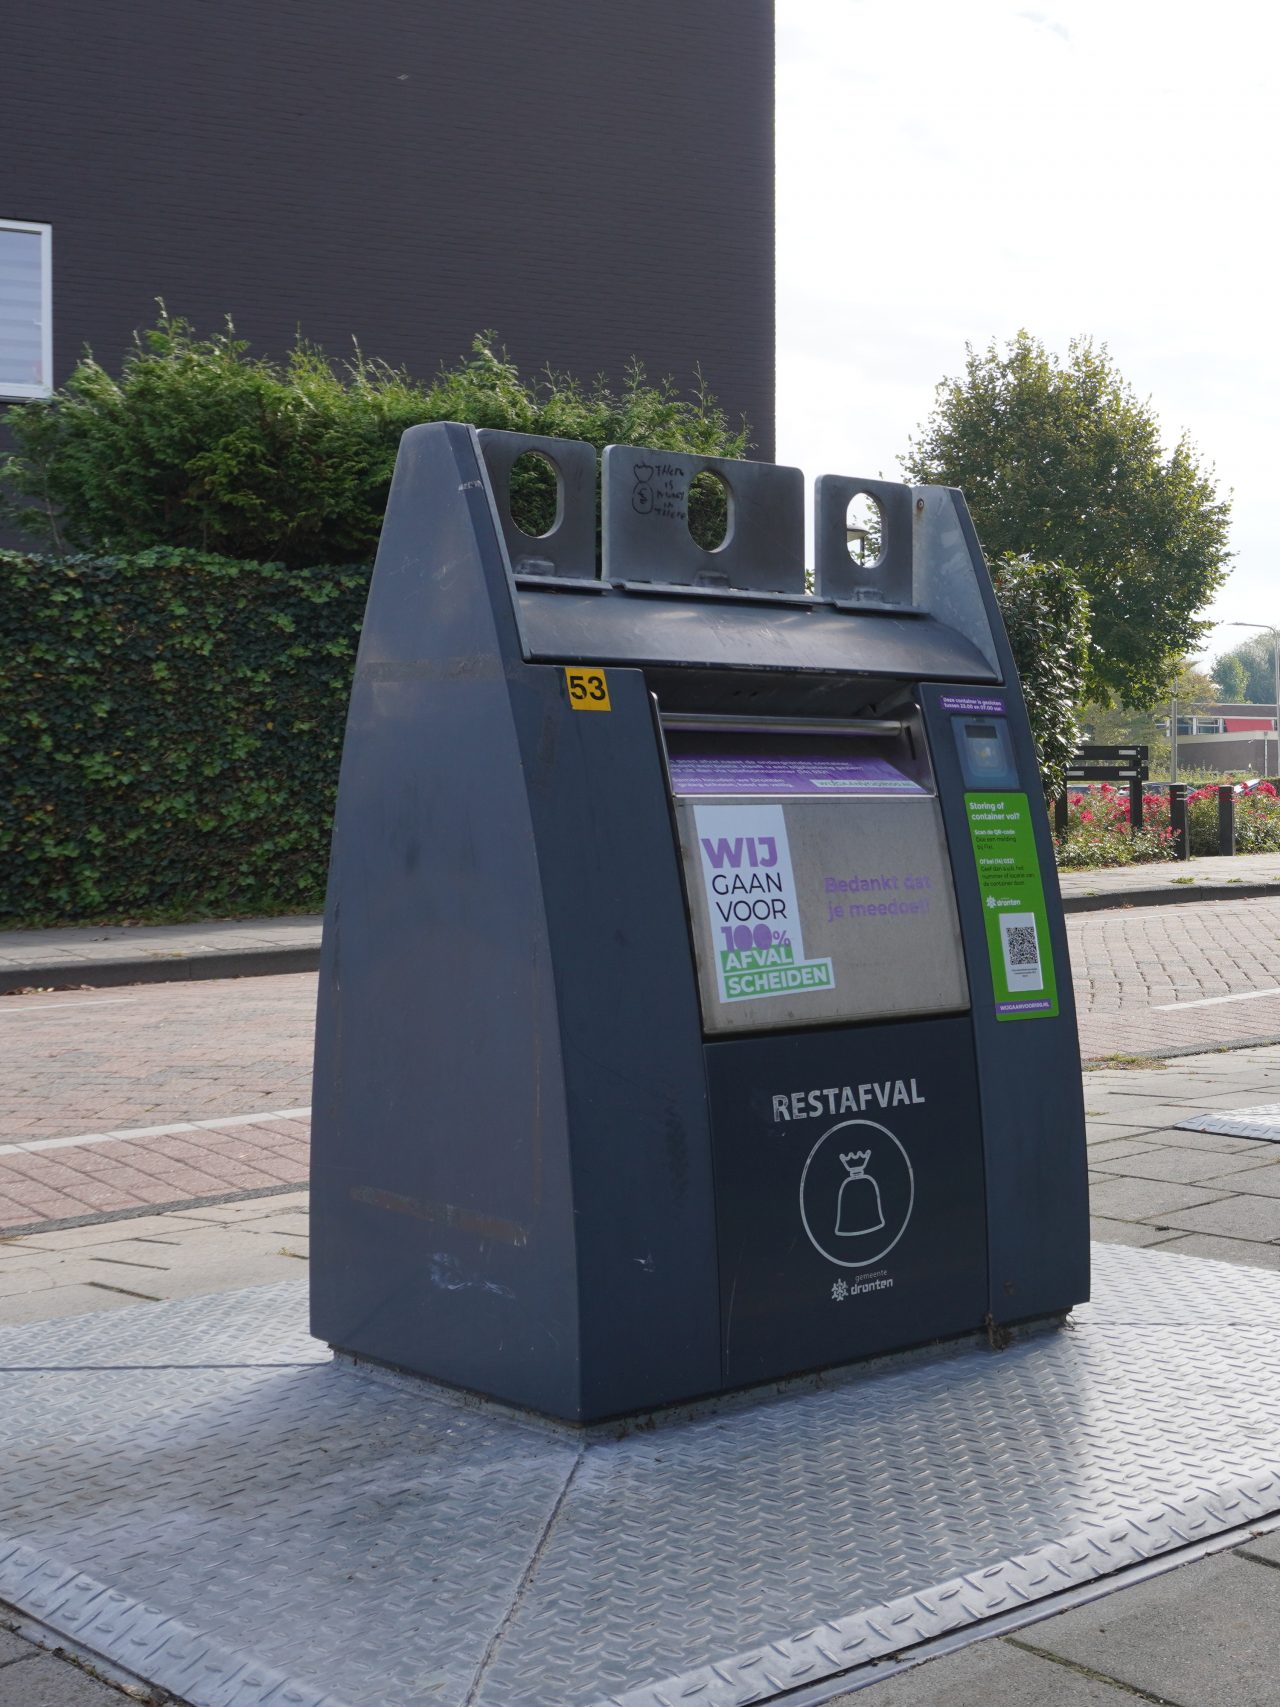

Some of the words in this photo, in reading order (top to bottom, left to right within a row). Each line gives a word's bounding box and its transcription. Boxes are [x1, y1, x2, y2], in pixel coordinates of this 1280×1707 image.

[569, 675, 606, 701] 53
[969, 802, 996, 811] Storing
[996, 802, 1004, 810] of
[1006, 812, 1020, 820] vol?
[700, 836, 778, 869] WIJ
[711, 872, 783, 896] GAAN
[824, 874, 898, 894] Bedankt
[903, 873, 932, 890] dat
[715, 898, 788, 923] VOOR
[827, 903, 844, 923] je
[996, 899, 1021, 907] dronten
[720, 923, 792, 953] 100%
[725, 946, 793, 971] AFVAL
[727, 966, 829, 996] SCHEIDEN
[771, 1078, 926, 1122] RESTAFVAL
[850, 1278, 893, 1296] dronten
[855, 1269, 888, 1284] gemeente
